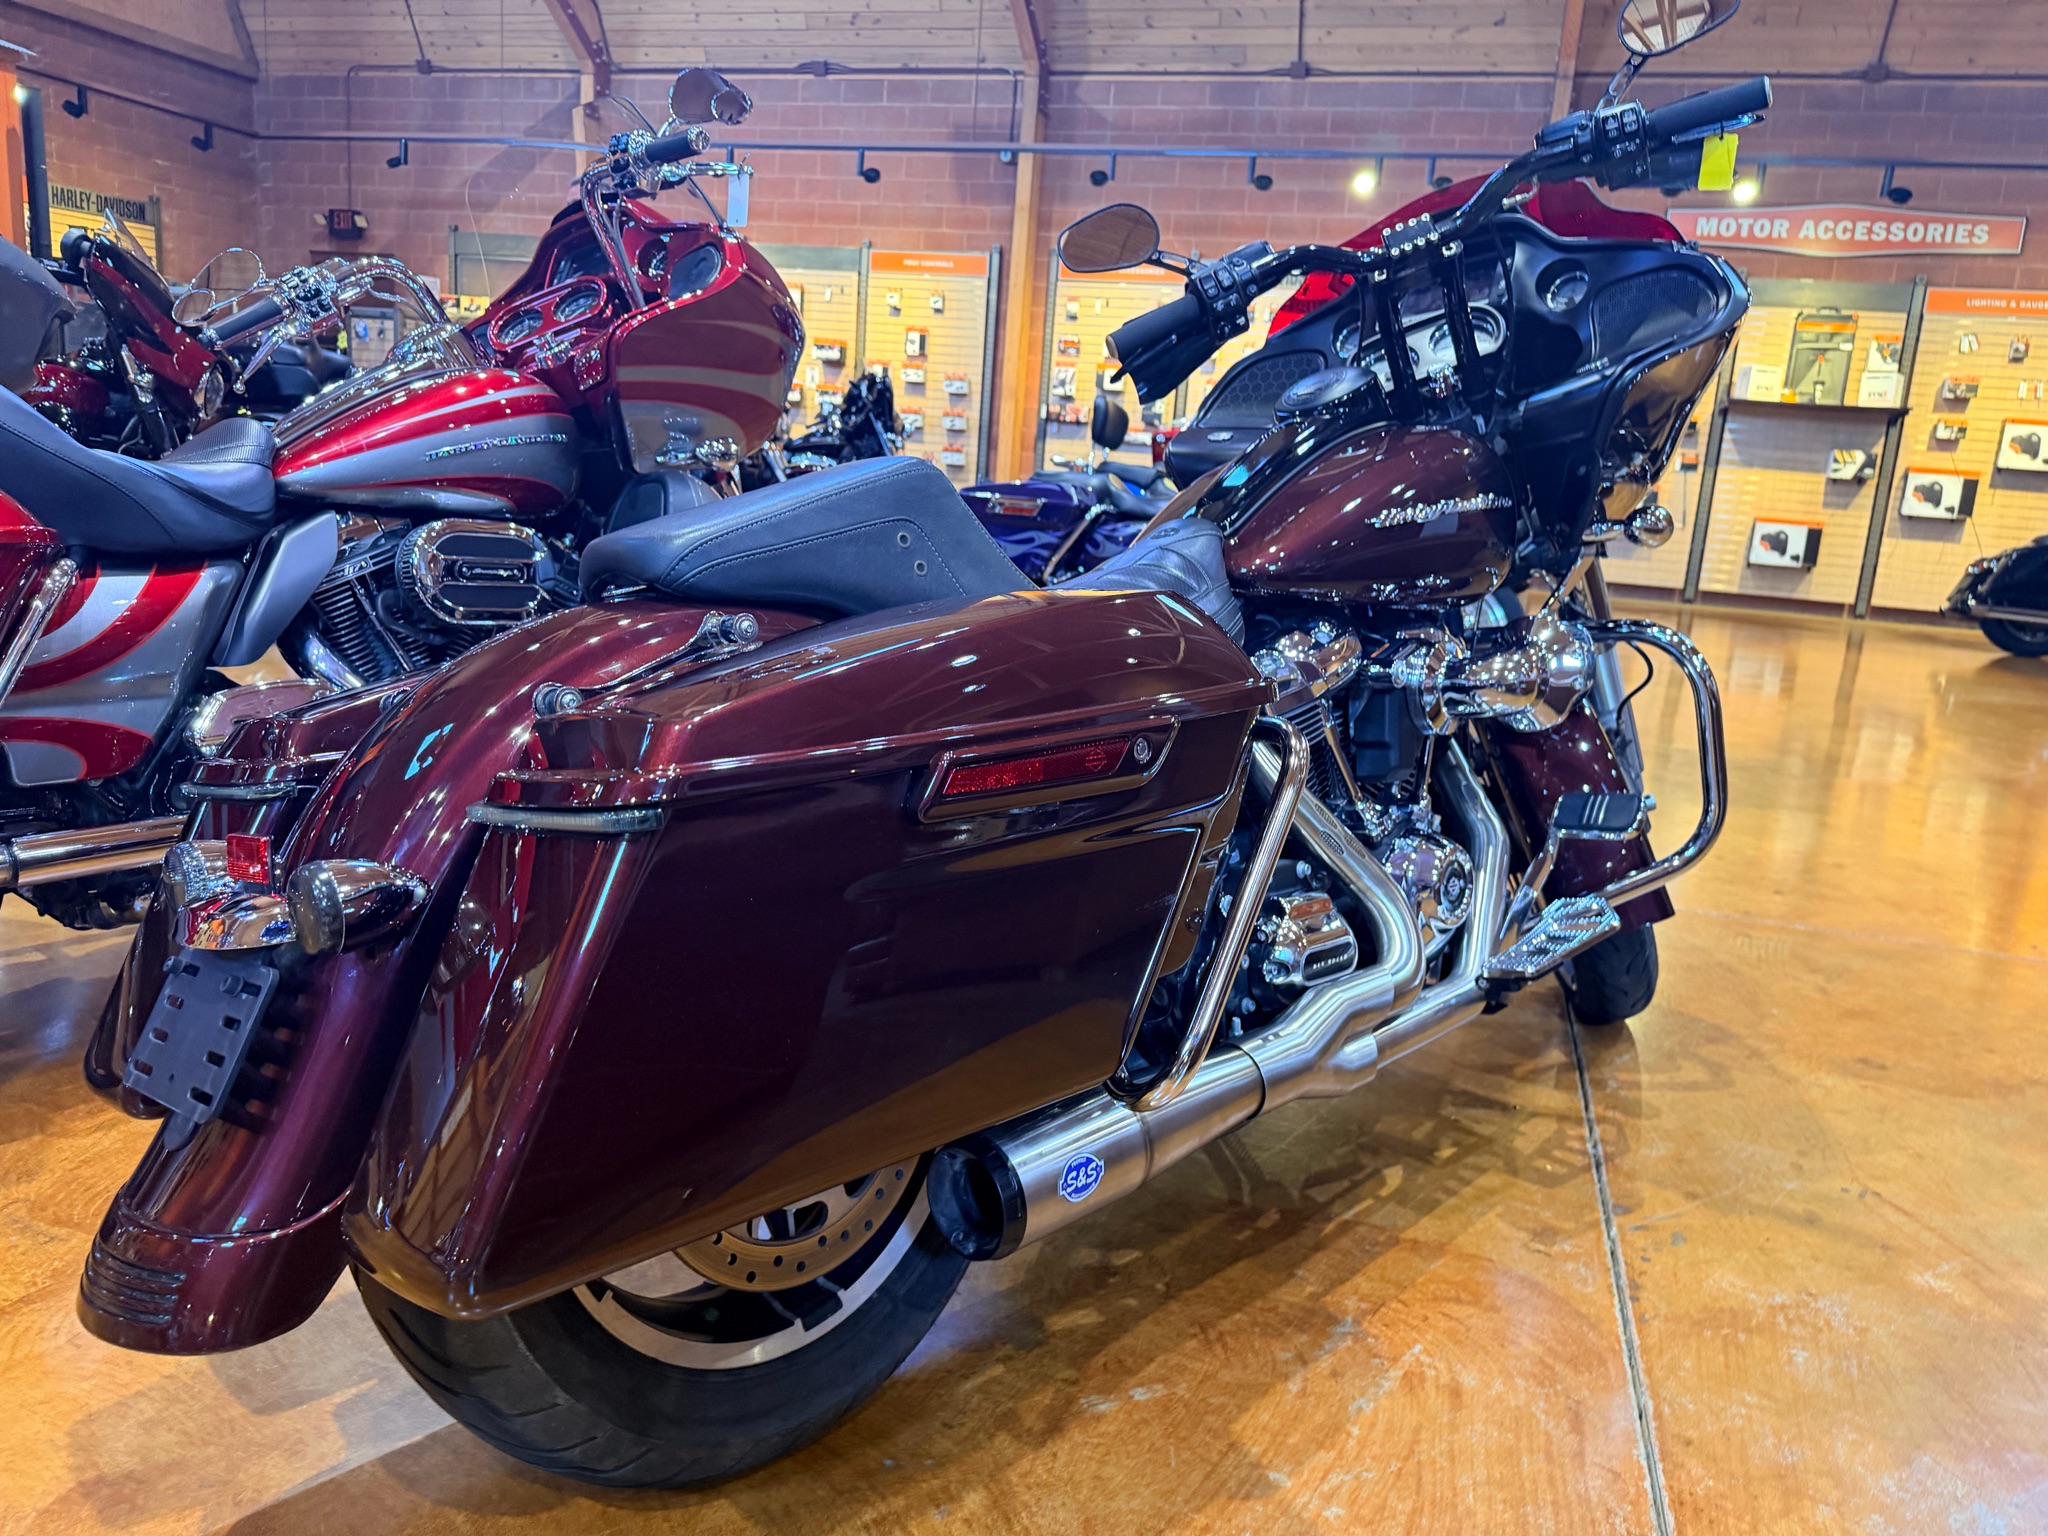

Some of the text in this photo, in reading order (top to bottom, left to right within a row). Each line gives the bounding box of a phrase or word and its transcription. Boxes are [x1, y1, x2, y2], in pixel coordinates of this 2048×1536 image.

[50, 185, 146, 221] HARLEY-DAVIDSON
[1695, 216, 1990, 244] MOTOR ACCESSORIES
[1966, 298, 2007, 308] LIGHTING
[1066, 1161, 1097, 1194] S&S
